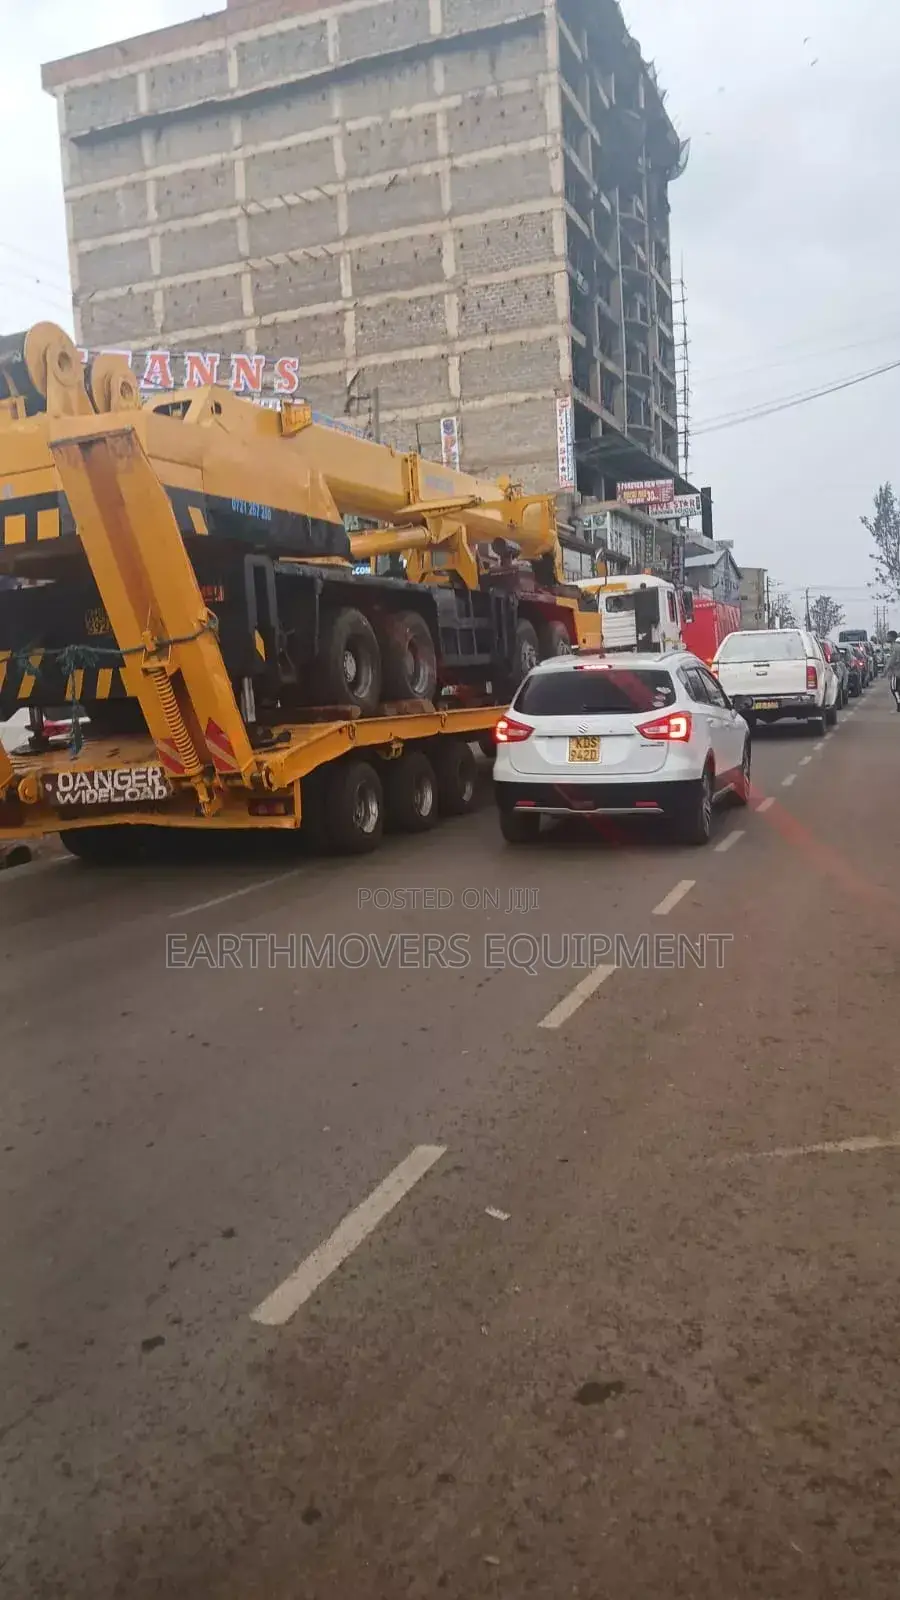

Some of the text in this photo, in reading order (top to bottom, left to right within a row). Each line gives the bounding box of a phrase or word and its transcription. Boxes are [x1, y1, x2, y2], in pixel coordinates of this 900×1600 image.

[77, 348, 299, 393] ANNS
[57, 766, 162, 792] DANGER
[56, 785, 168, 804] WIDELOAD
